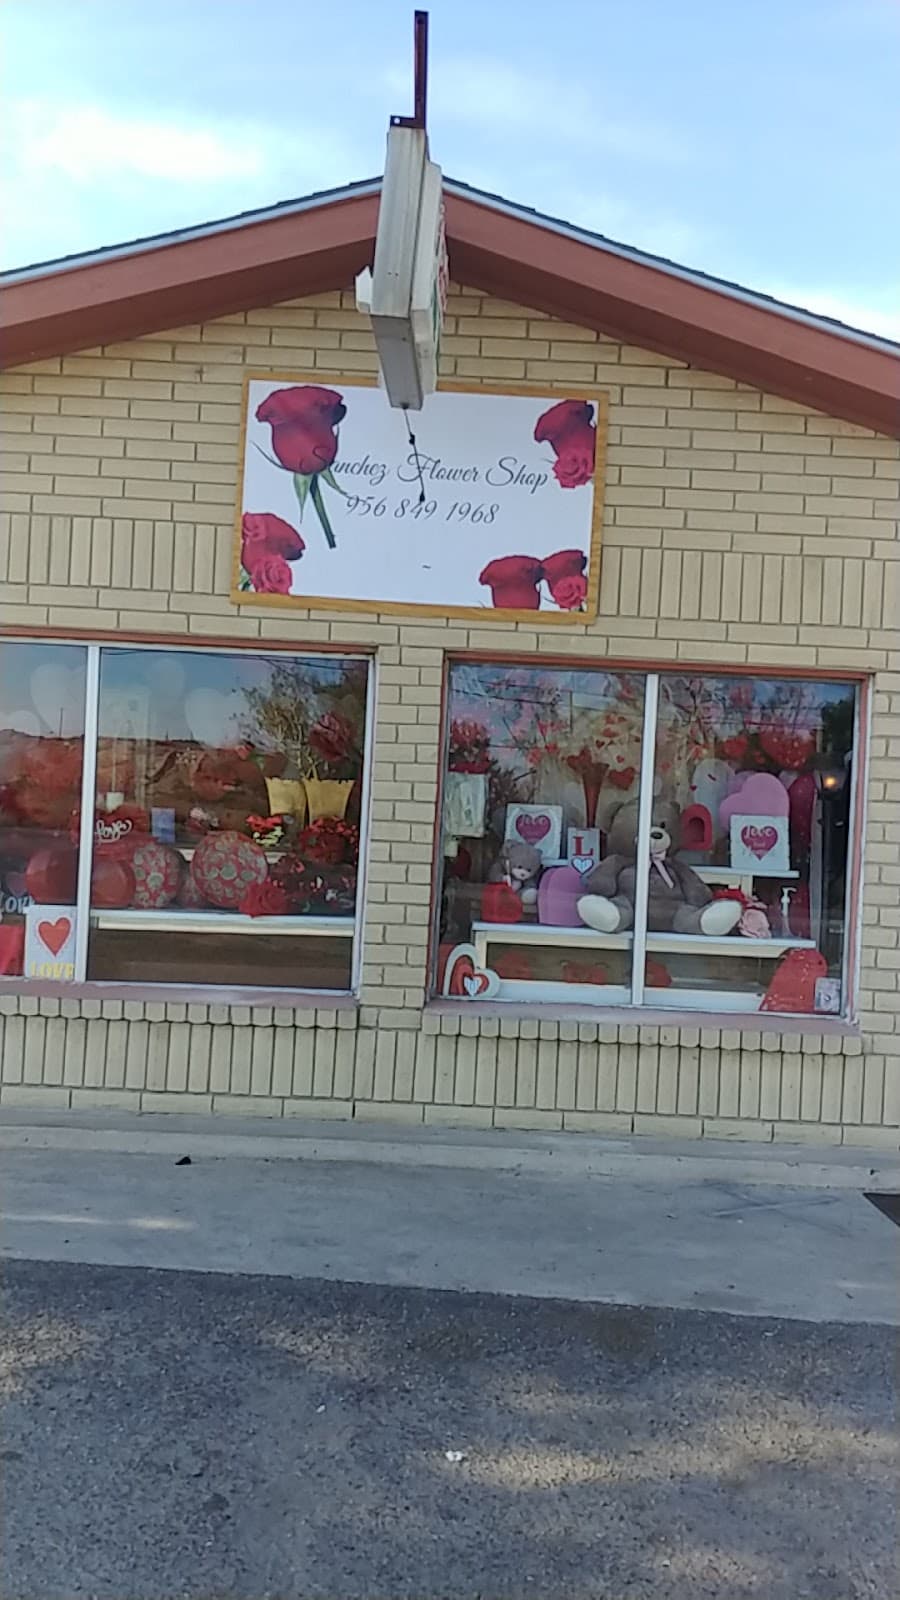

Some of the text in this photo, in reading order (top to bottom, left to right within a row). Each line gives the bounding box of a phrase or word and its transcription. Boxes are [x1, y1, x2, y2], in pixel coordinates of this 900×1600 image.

[397, 453, 479, 482] Flower
[485, 456, 548, 494] Shop
[346, 495, 500, 524] 956 849 1968
